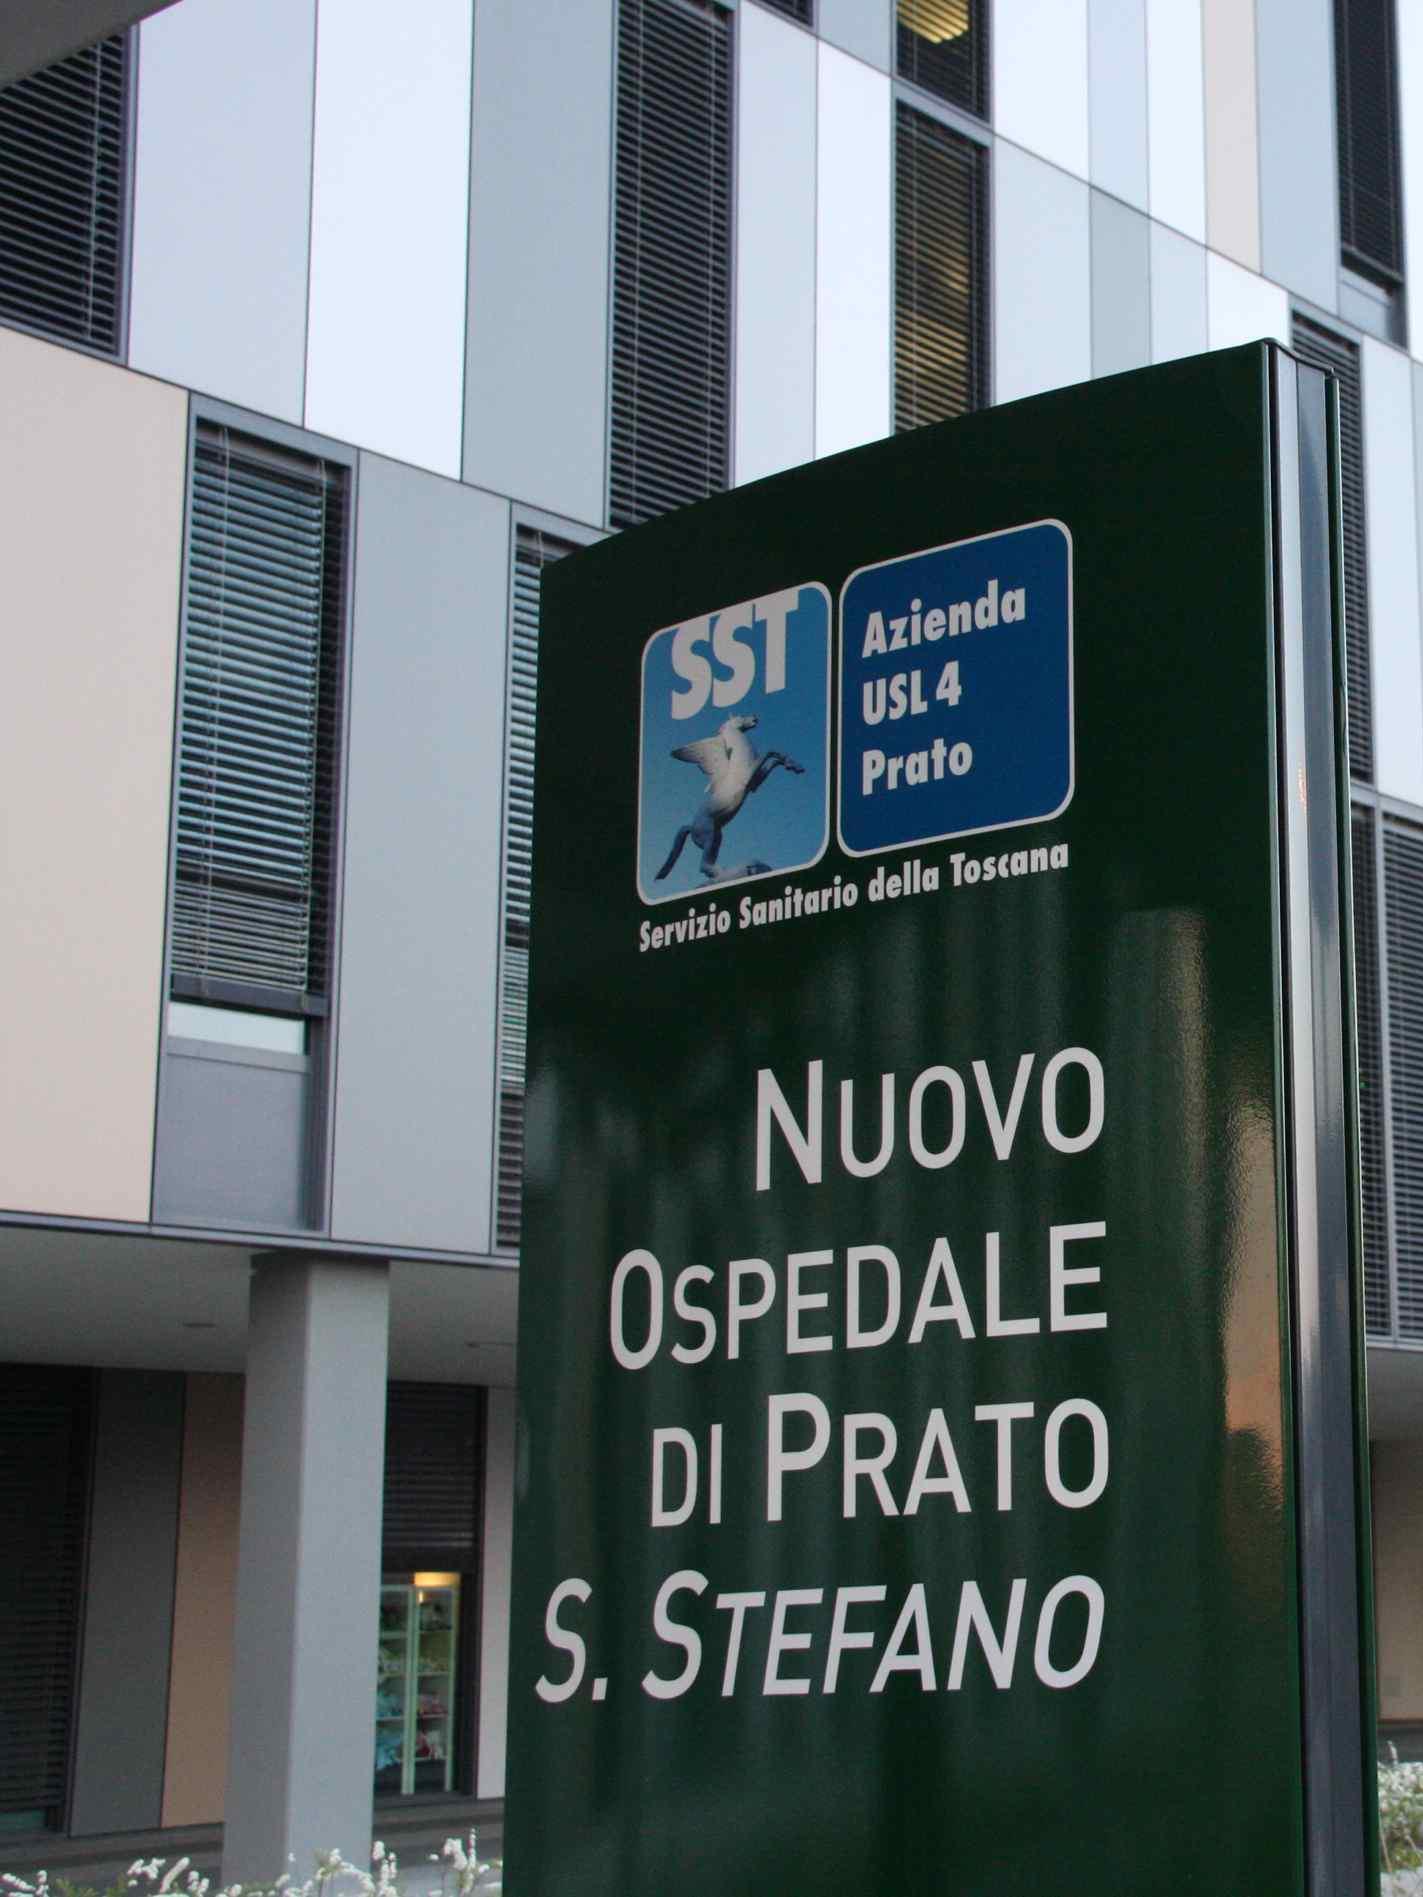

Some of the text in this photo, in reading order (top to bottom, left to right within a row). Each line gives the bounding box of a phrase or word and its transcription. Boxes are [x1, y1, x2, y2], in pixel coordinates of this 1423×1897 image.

[671, 590, 800, 720] SST
[861, 579, 1026, 658] Azienda
[862, 660, 962, 726] USL 4
[862, 738, 973, 796] Prato
[639, 843, 1069, 952] Servizio Sanitario della Toscana
[755, 1046, 1105, 1192] NUOVO
[610, 1220, 1108, 1370] OSPEDALE
[651, 1392, 1109, 1528] DI PRATO
[535, 1569, 1105, 1703] S. STEFANO
